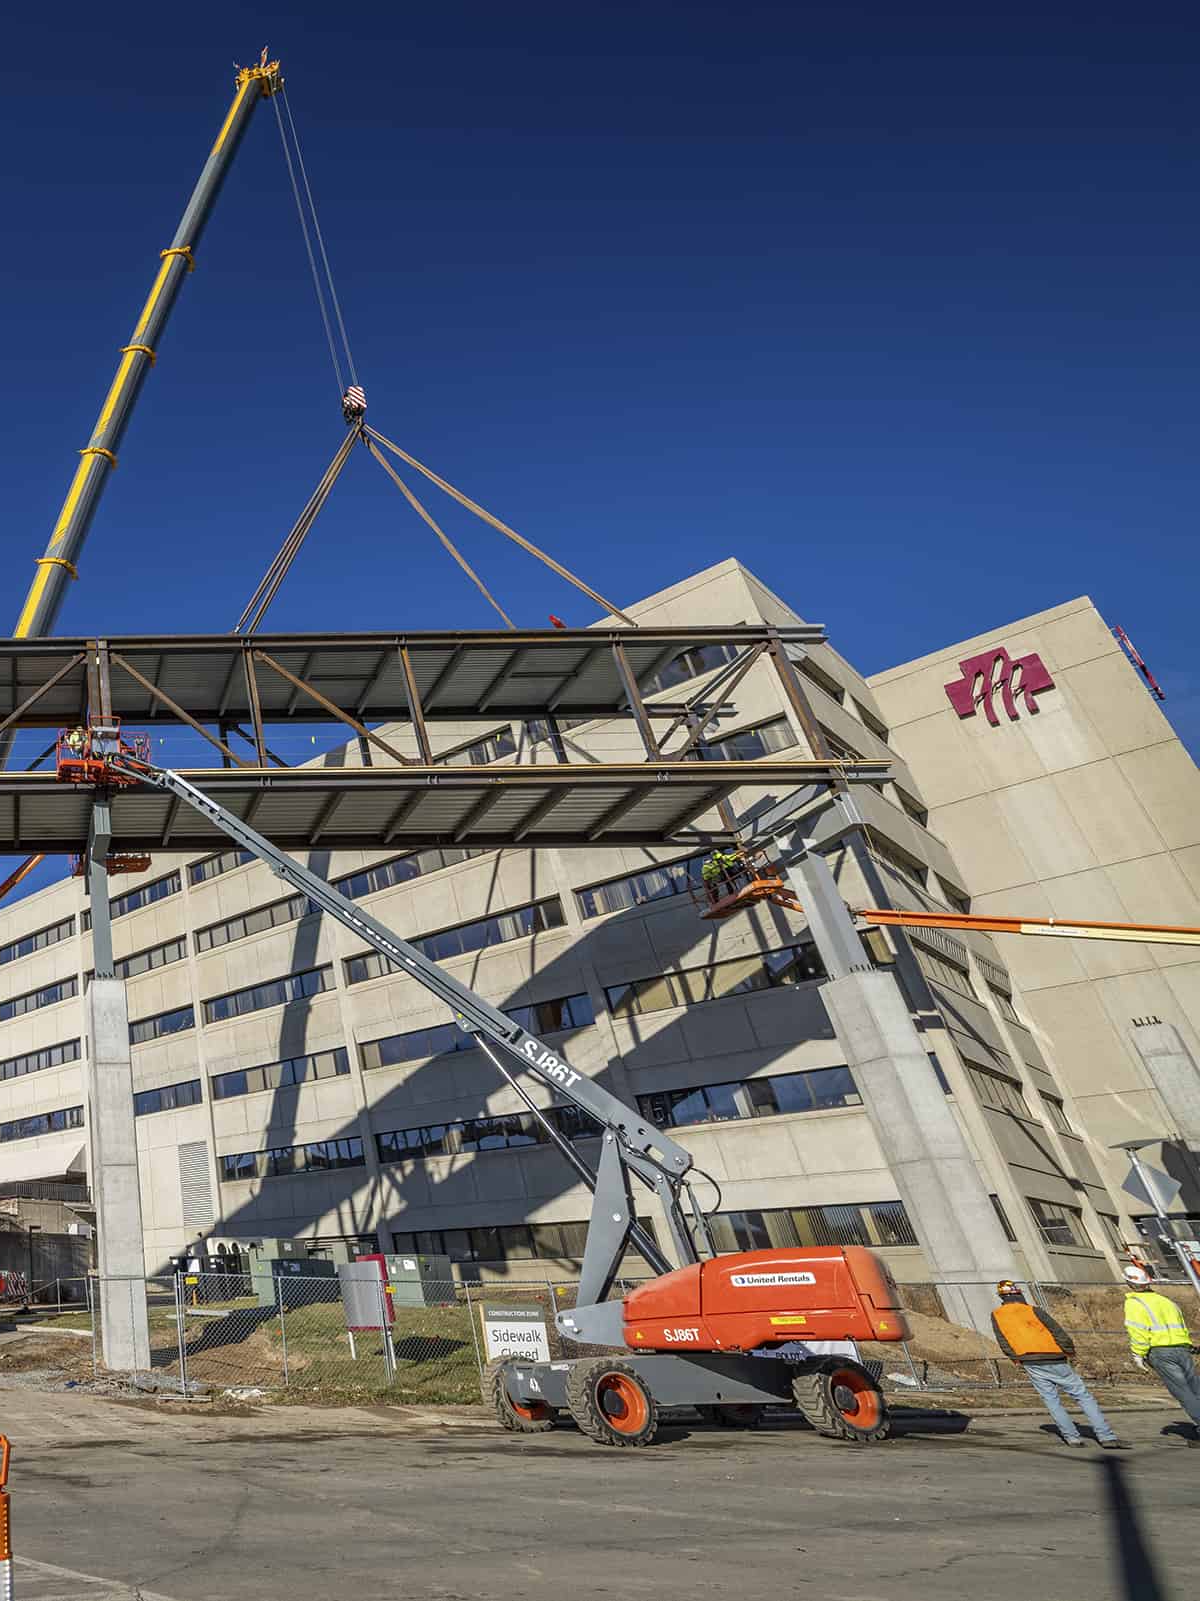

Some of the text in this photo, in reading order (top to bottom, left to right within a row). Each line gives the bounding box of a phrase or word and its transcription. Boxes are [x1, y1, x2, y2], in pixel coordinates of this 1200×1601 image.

[520, 1040, 582, 1087] SJ86T
[746, 1274, 811, 1284] United Rentals
[492, 1329, 542, 1342] Sidewalk
[663, 1328, 700, 1342] SJ86T
[501, 1348, 539, 1360] Closed
